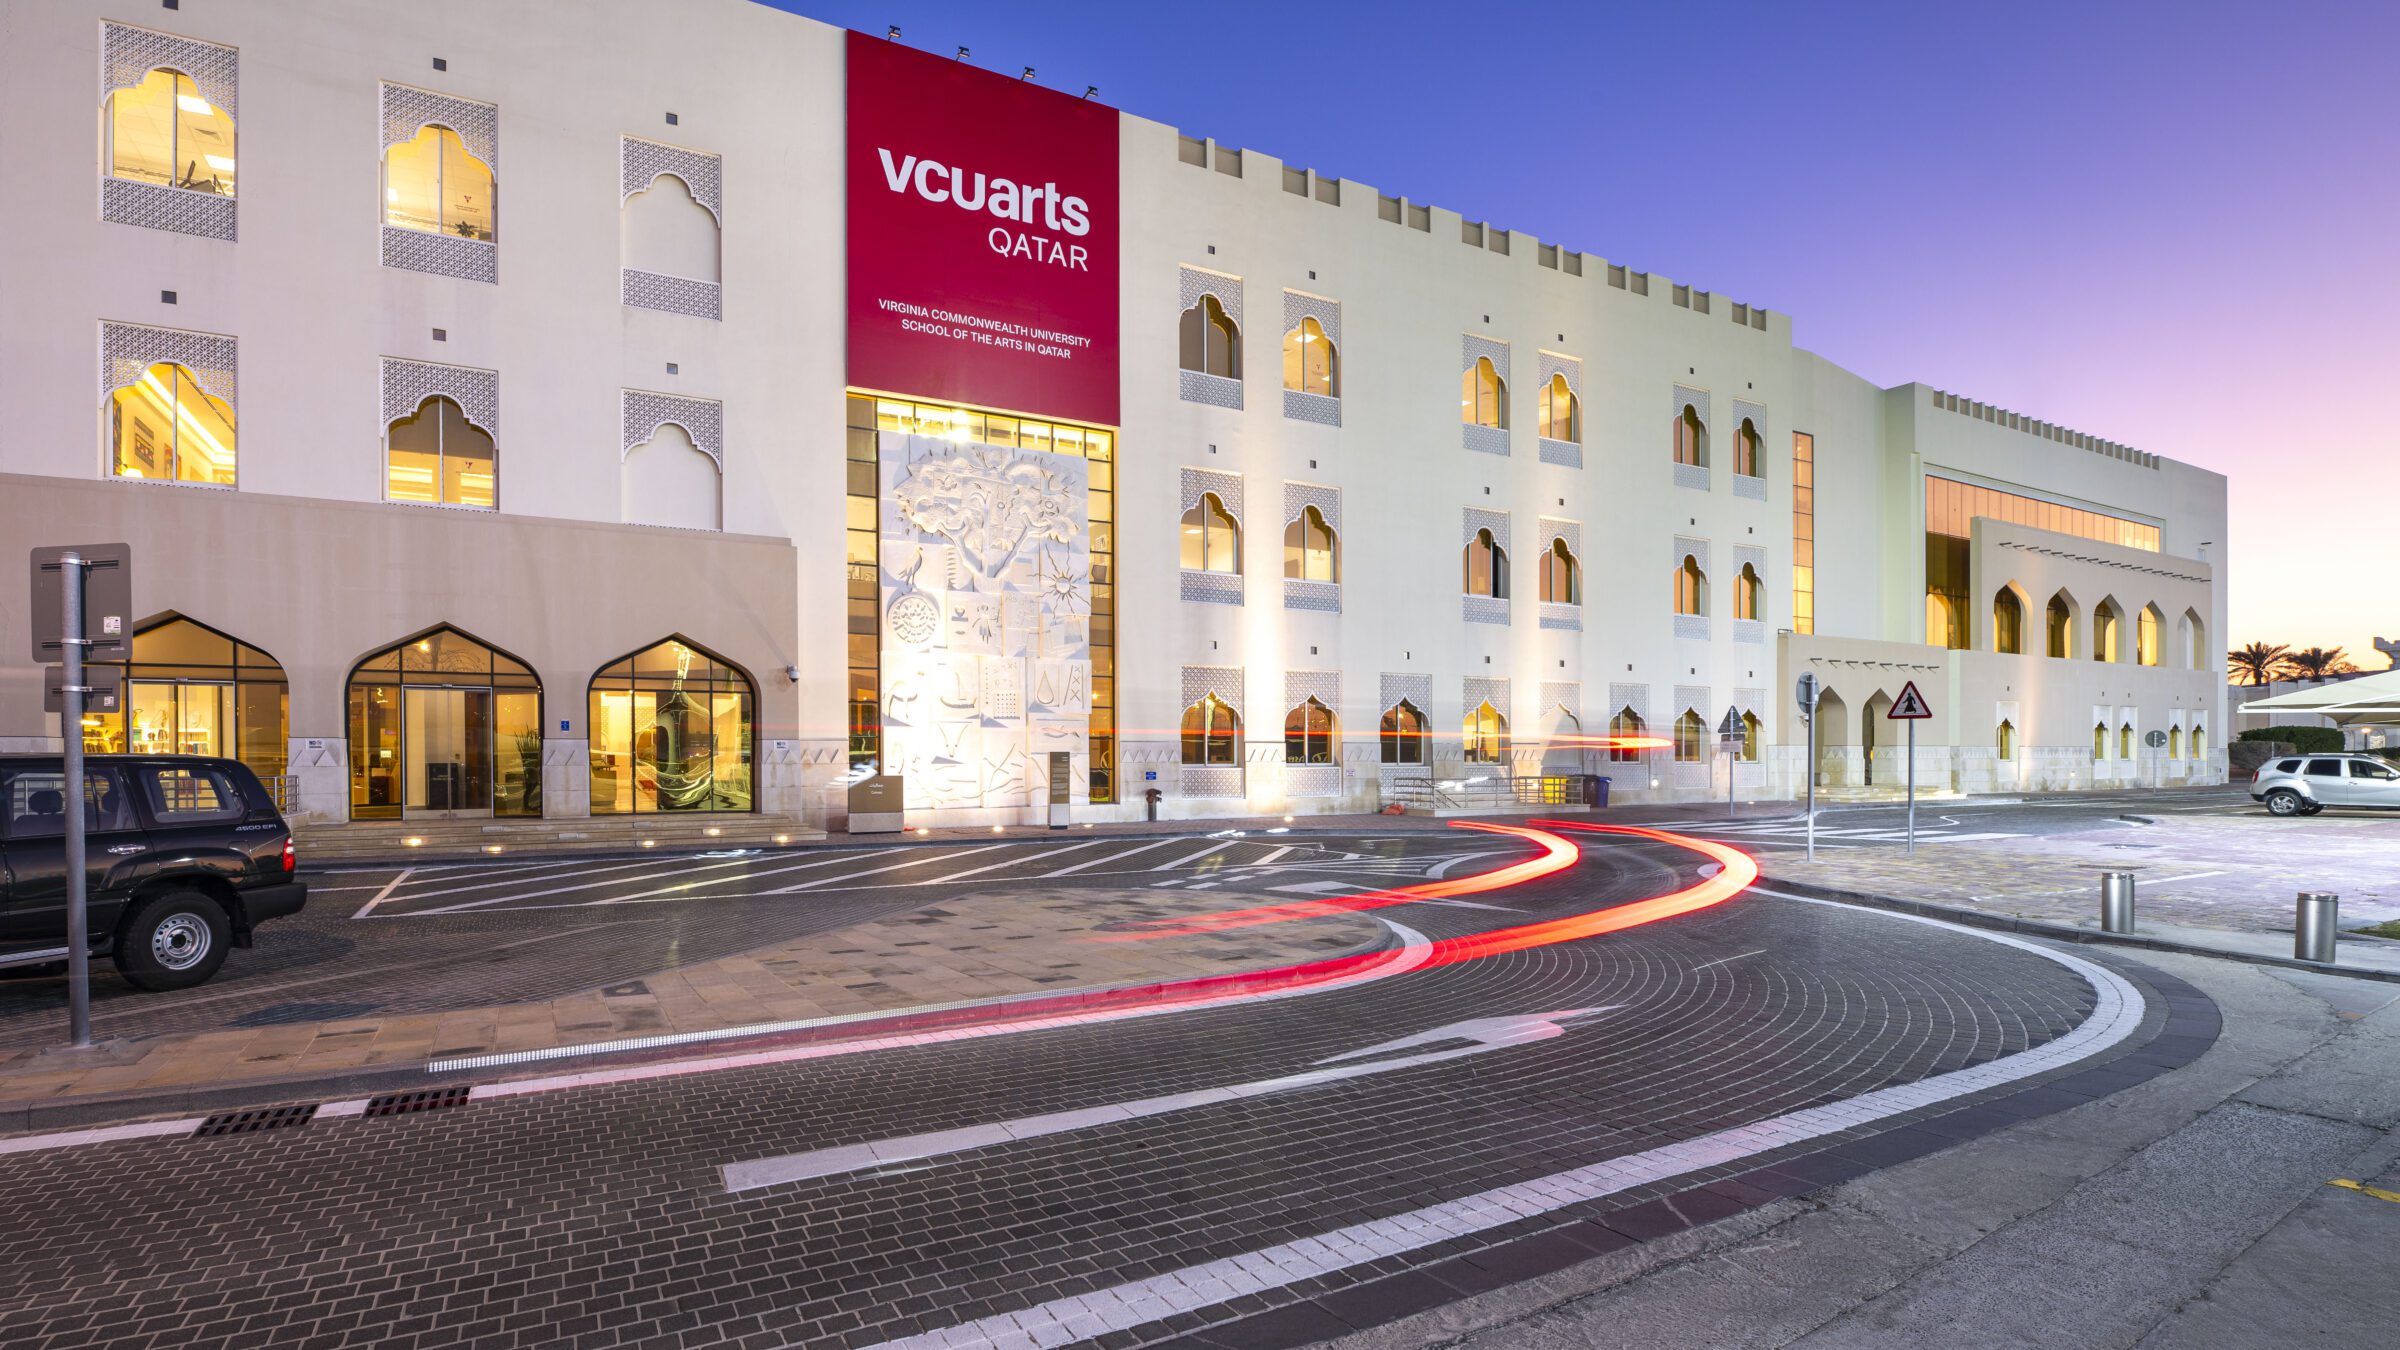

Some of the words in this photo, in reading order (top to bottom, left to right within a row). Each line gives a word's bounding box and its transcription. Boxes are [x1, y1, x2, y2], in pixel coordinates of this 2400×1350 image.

[988, 227, 1088, 272] QATAR
[878, 298, 929, 318] VIRGINIA
[931, 309, 1028, 336] COMMONWEALTH
[1030, 329, 1091, 348] UNIVERSITY
[902, 319, 951, 337] SCHOOL
[953, 329, 968, 340] OF
[970, 332, 992, 345] THE
[994, 338, 1022, 351] ARTS
[1024, 342, 1036, 353] IN
[1037, 345, 1071, 359] QATAR
